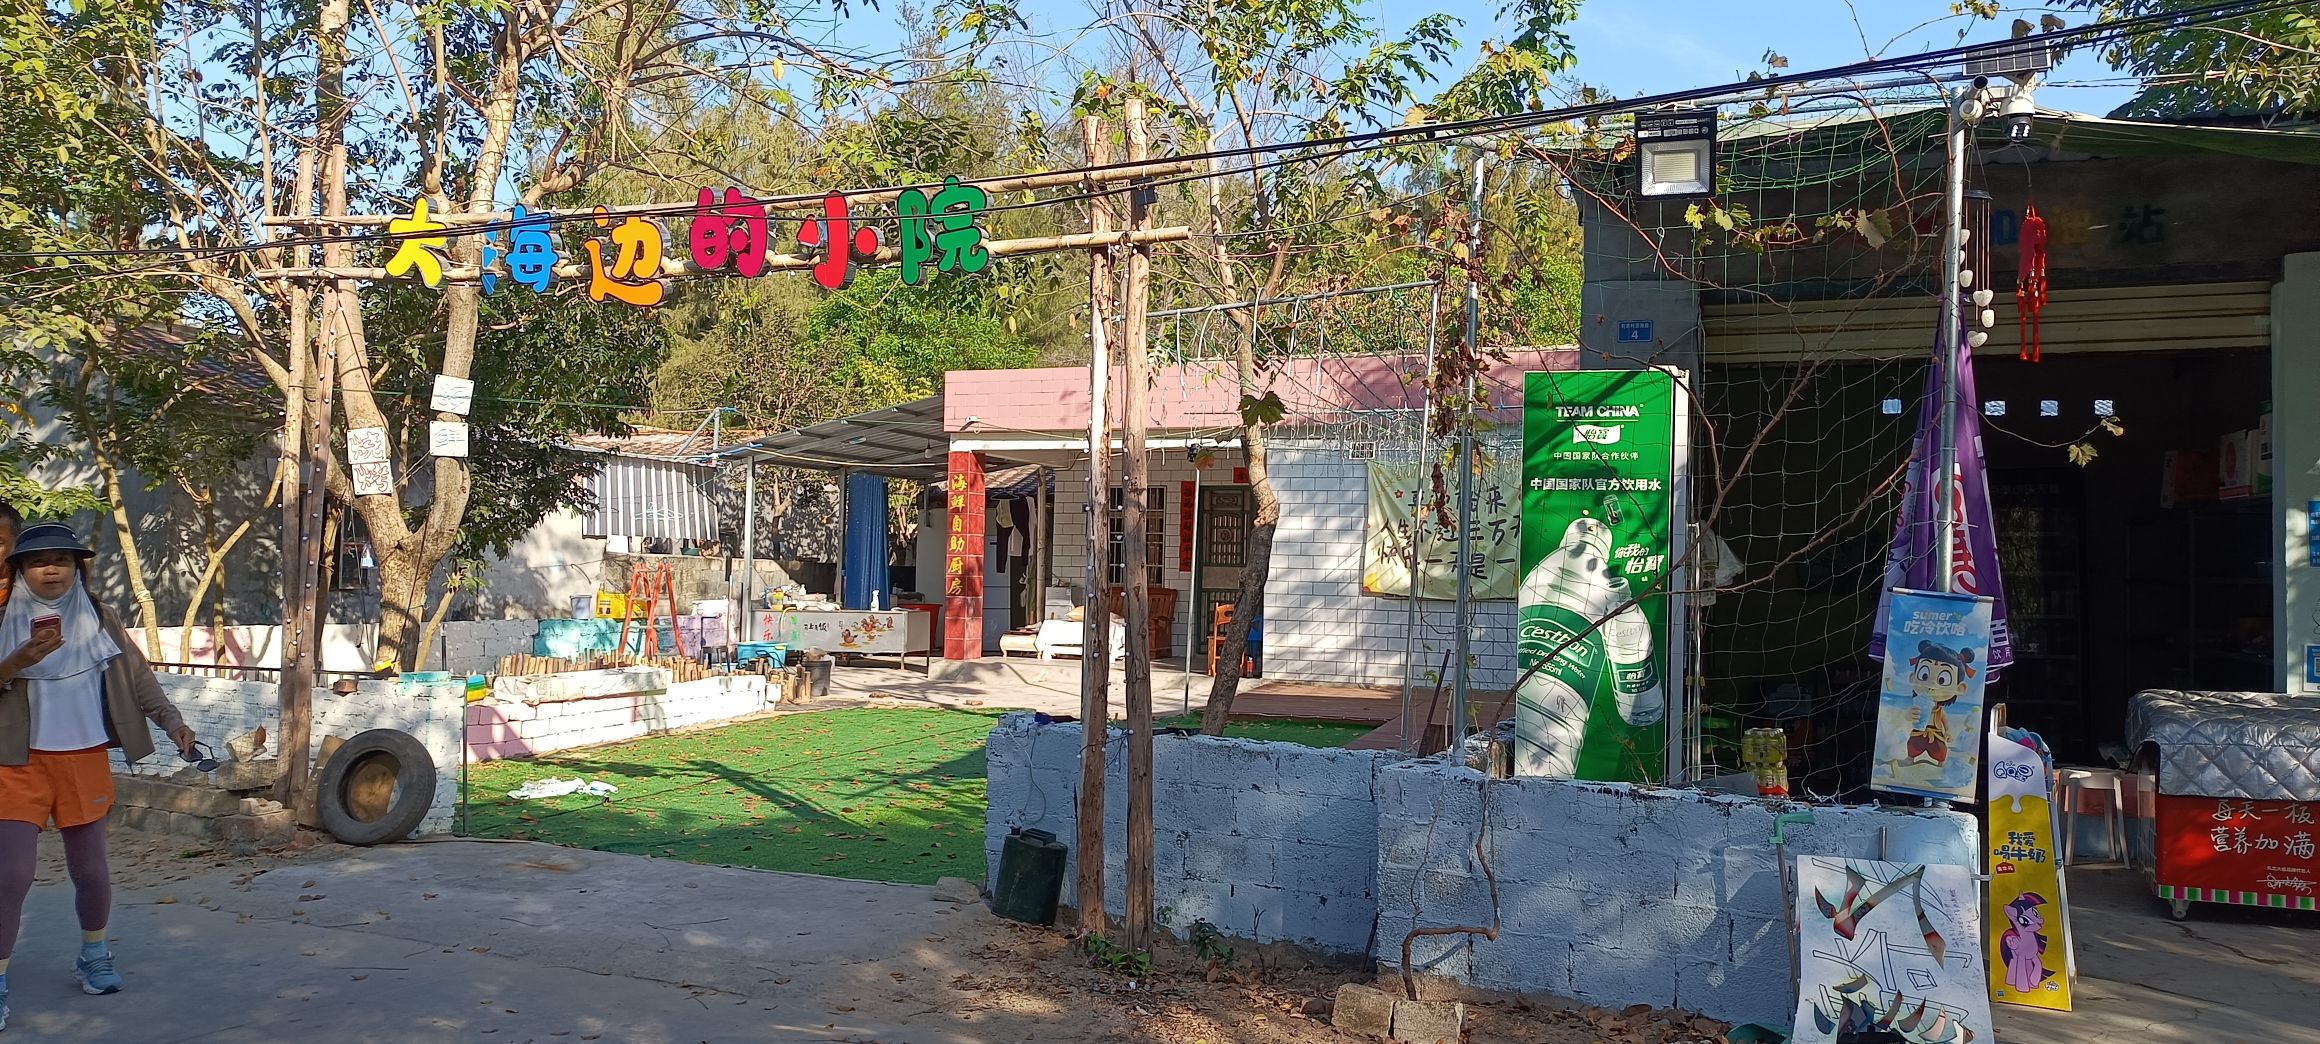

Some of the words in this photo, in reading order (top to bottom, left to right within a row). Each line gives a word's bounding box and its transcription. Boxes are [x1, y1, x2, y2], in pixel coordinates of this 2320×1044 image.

[385, 175, 988, 306] 大海边的小院
[1631, 330, 1639, 340] 4
[1555, 406, 1593, 417] TEAM
[1596, 406, 1640, 417] CHINA
[1553, 451, 1639, 461] 中国国家队合作伙伴
[1530, 477, 1662, 491] 中国国家队官方饮用水
[947, 473, 968, 596] 海鲜自助厨房
[1912, 611, 1953, 621] sumer
[2211, 800, 2315, 825] 每天一板
[2007, 831, 2036, 847] 我爱
[2210, 826, 2316, 860] 营养加满
[1993, 845, 2046, 863] 喝牛奶
